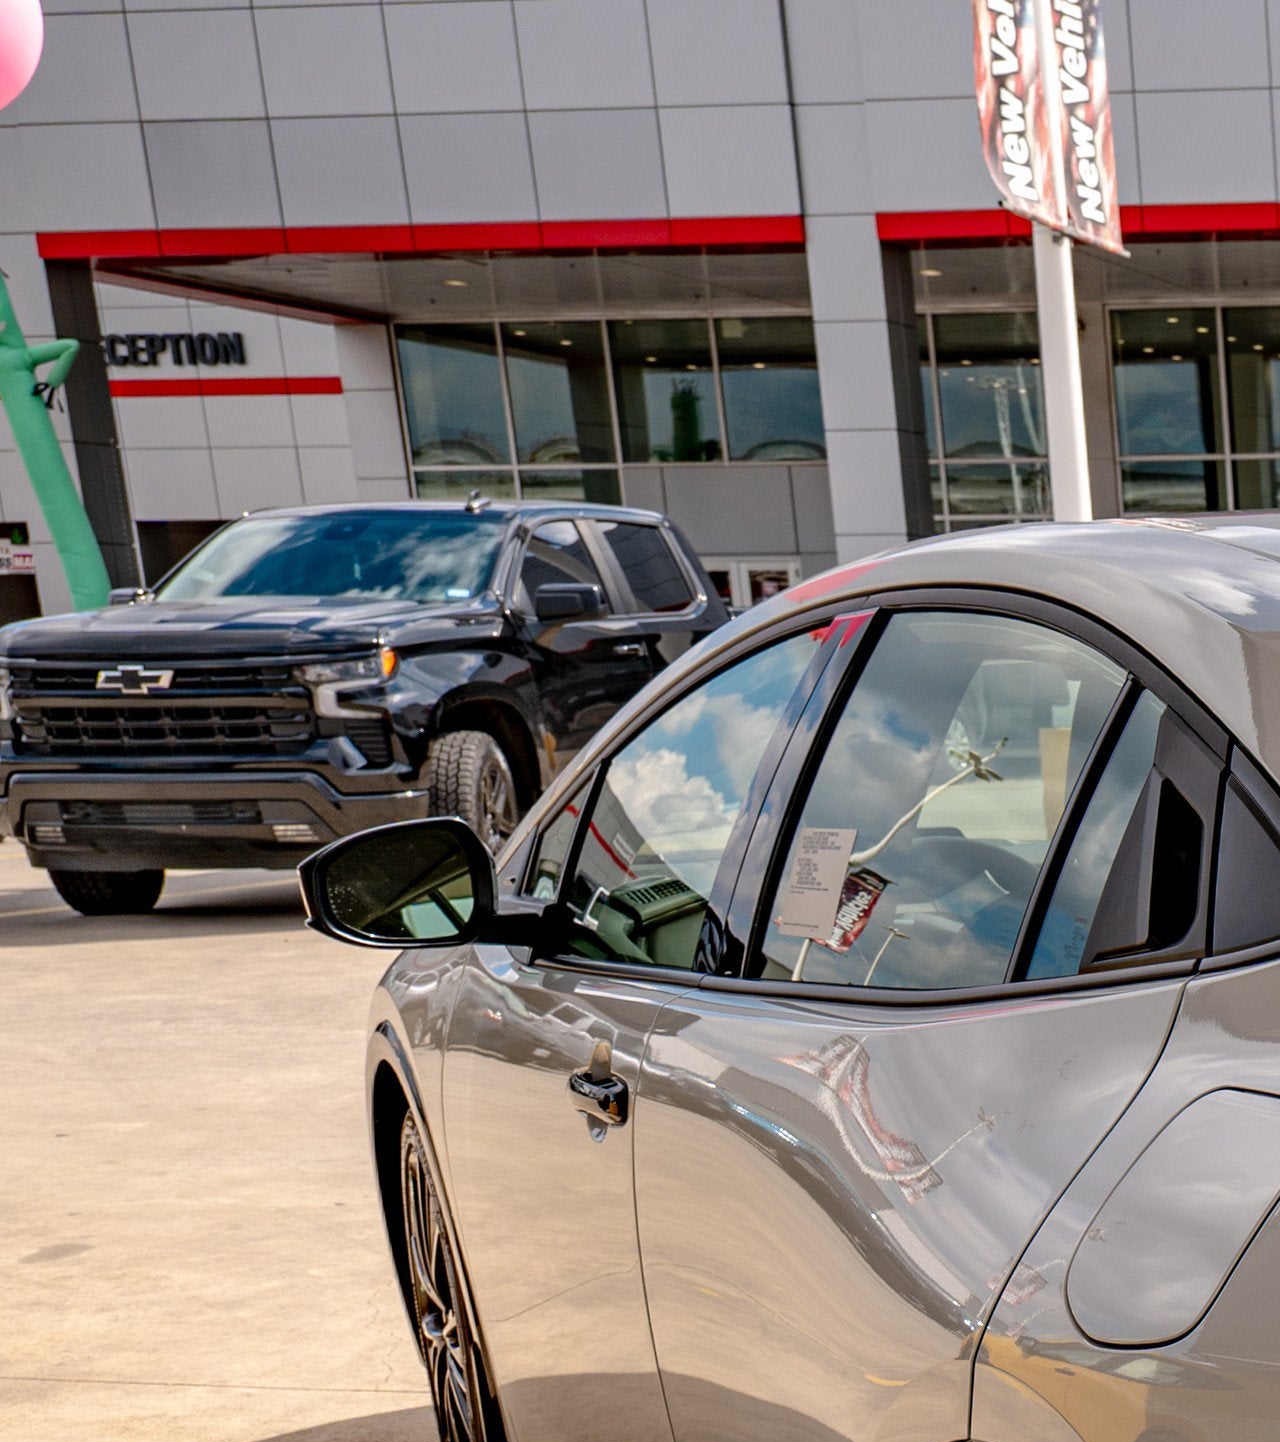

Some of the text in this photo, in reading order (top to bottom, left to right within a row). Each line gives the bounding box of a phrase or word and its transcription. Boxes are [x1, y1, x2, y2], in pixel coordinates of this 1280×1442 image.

[1002, 86, 1040, 201] New
[1053, 0, 1106, 224] New Vehi
[101, 332, 246, 366] CEPTION
